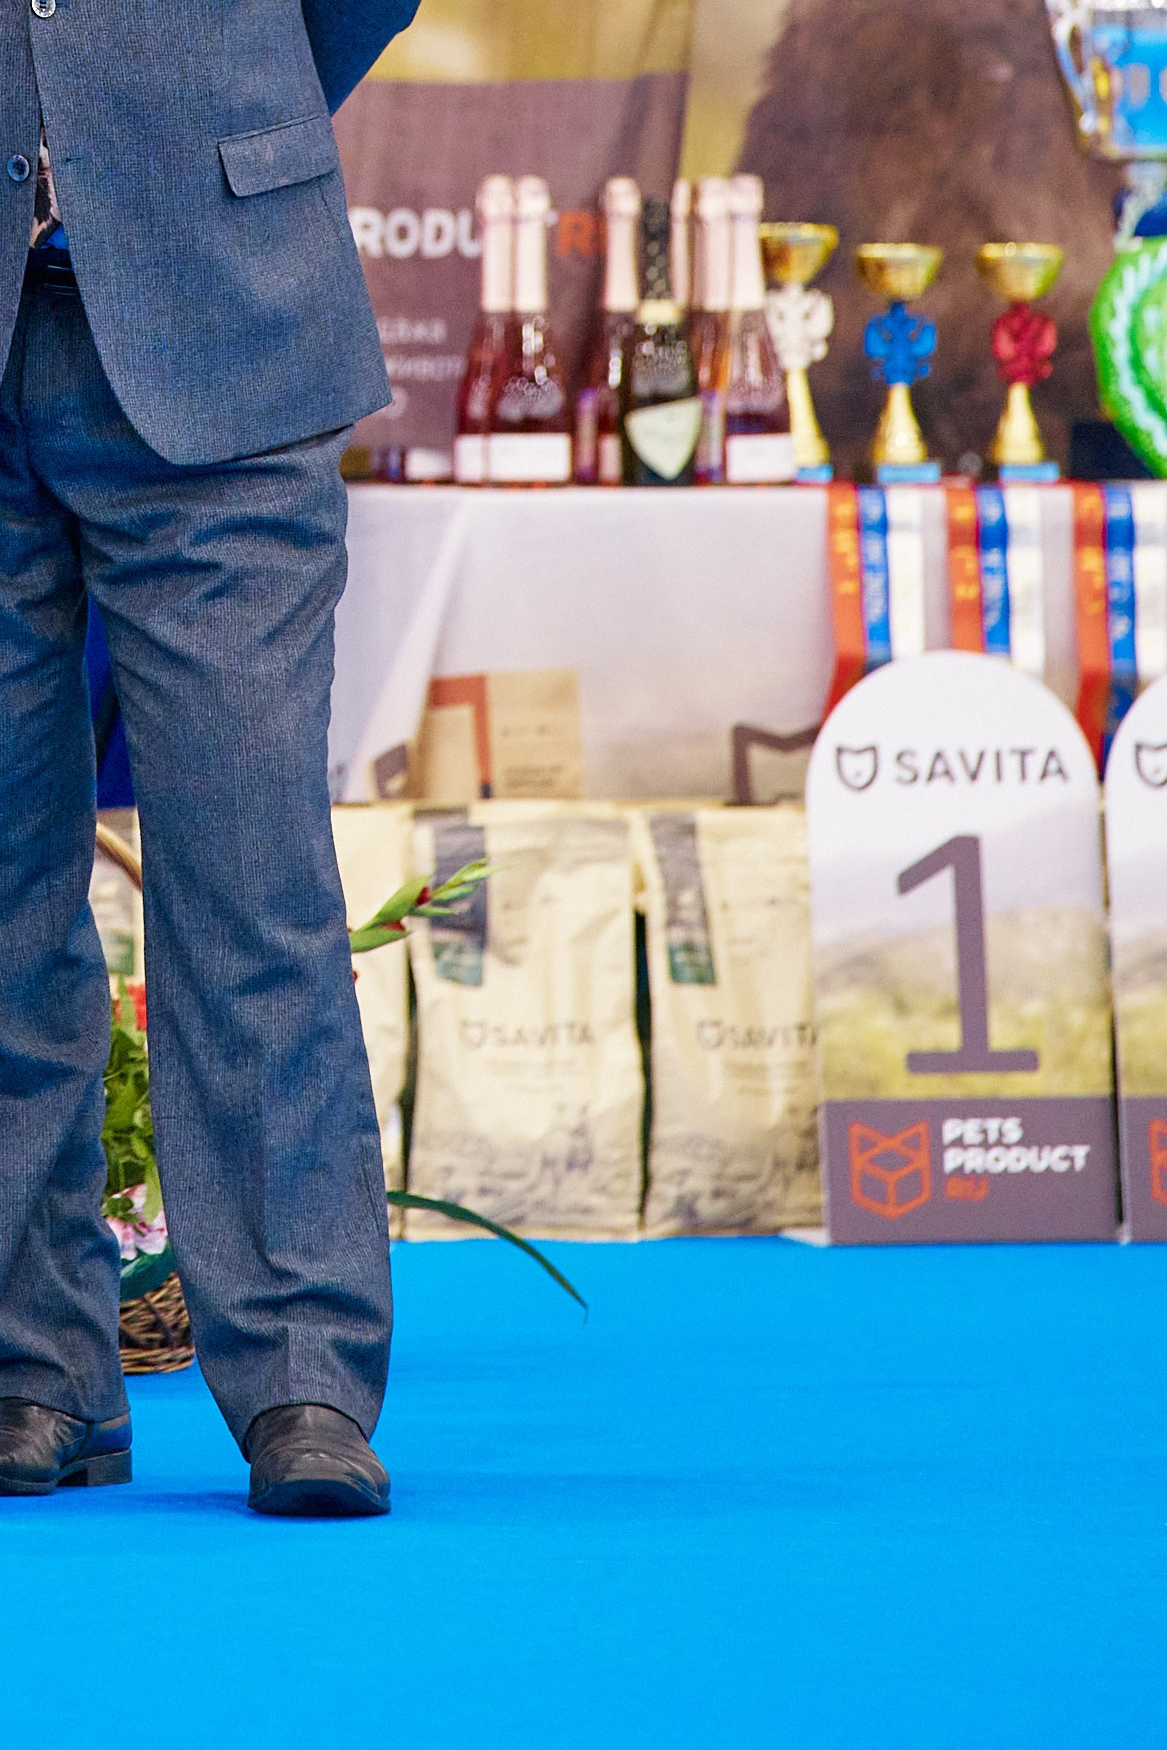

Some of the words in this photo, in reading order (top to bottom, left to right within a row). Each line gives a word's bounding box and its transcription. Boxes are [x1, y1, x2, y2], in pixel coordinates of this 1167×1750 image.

[894, 747, 1069, 785] SAVITA
[897, 834, 1039, 1074] 1
[941, 1116, 1024, 1145] PETS
[942, 1144, 1091, 1175] PRODUCT
